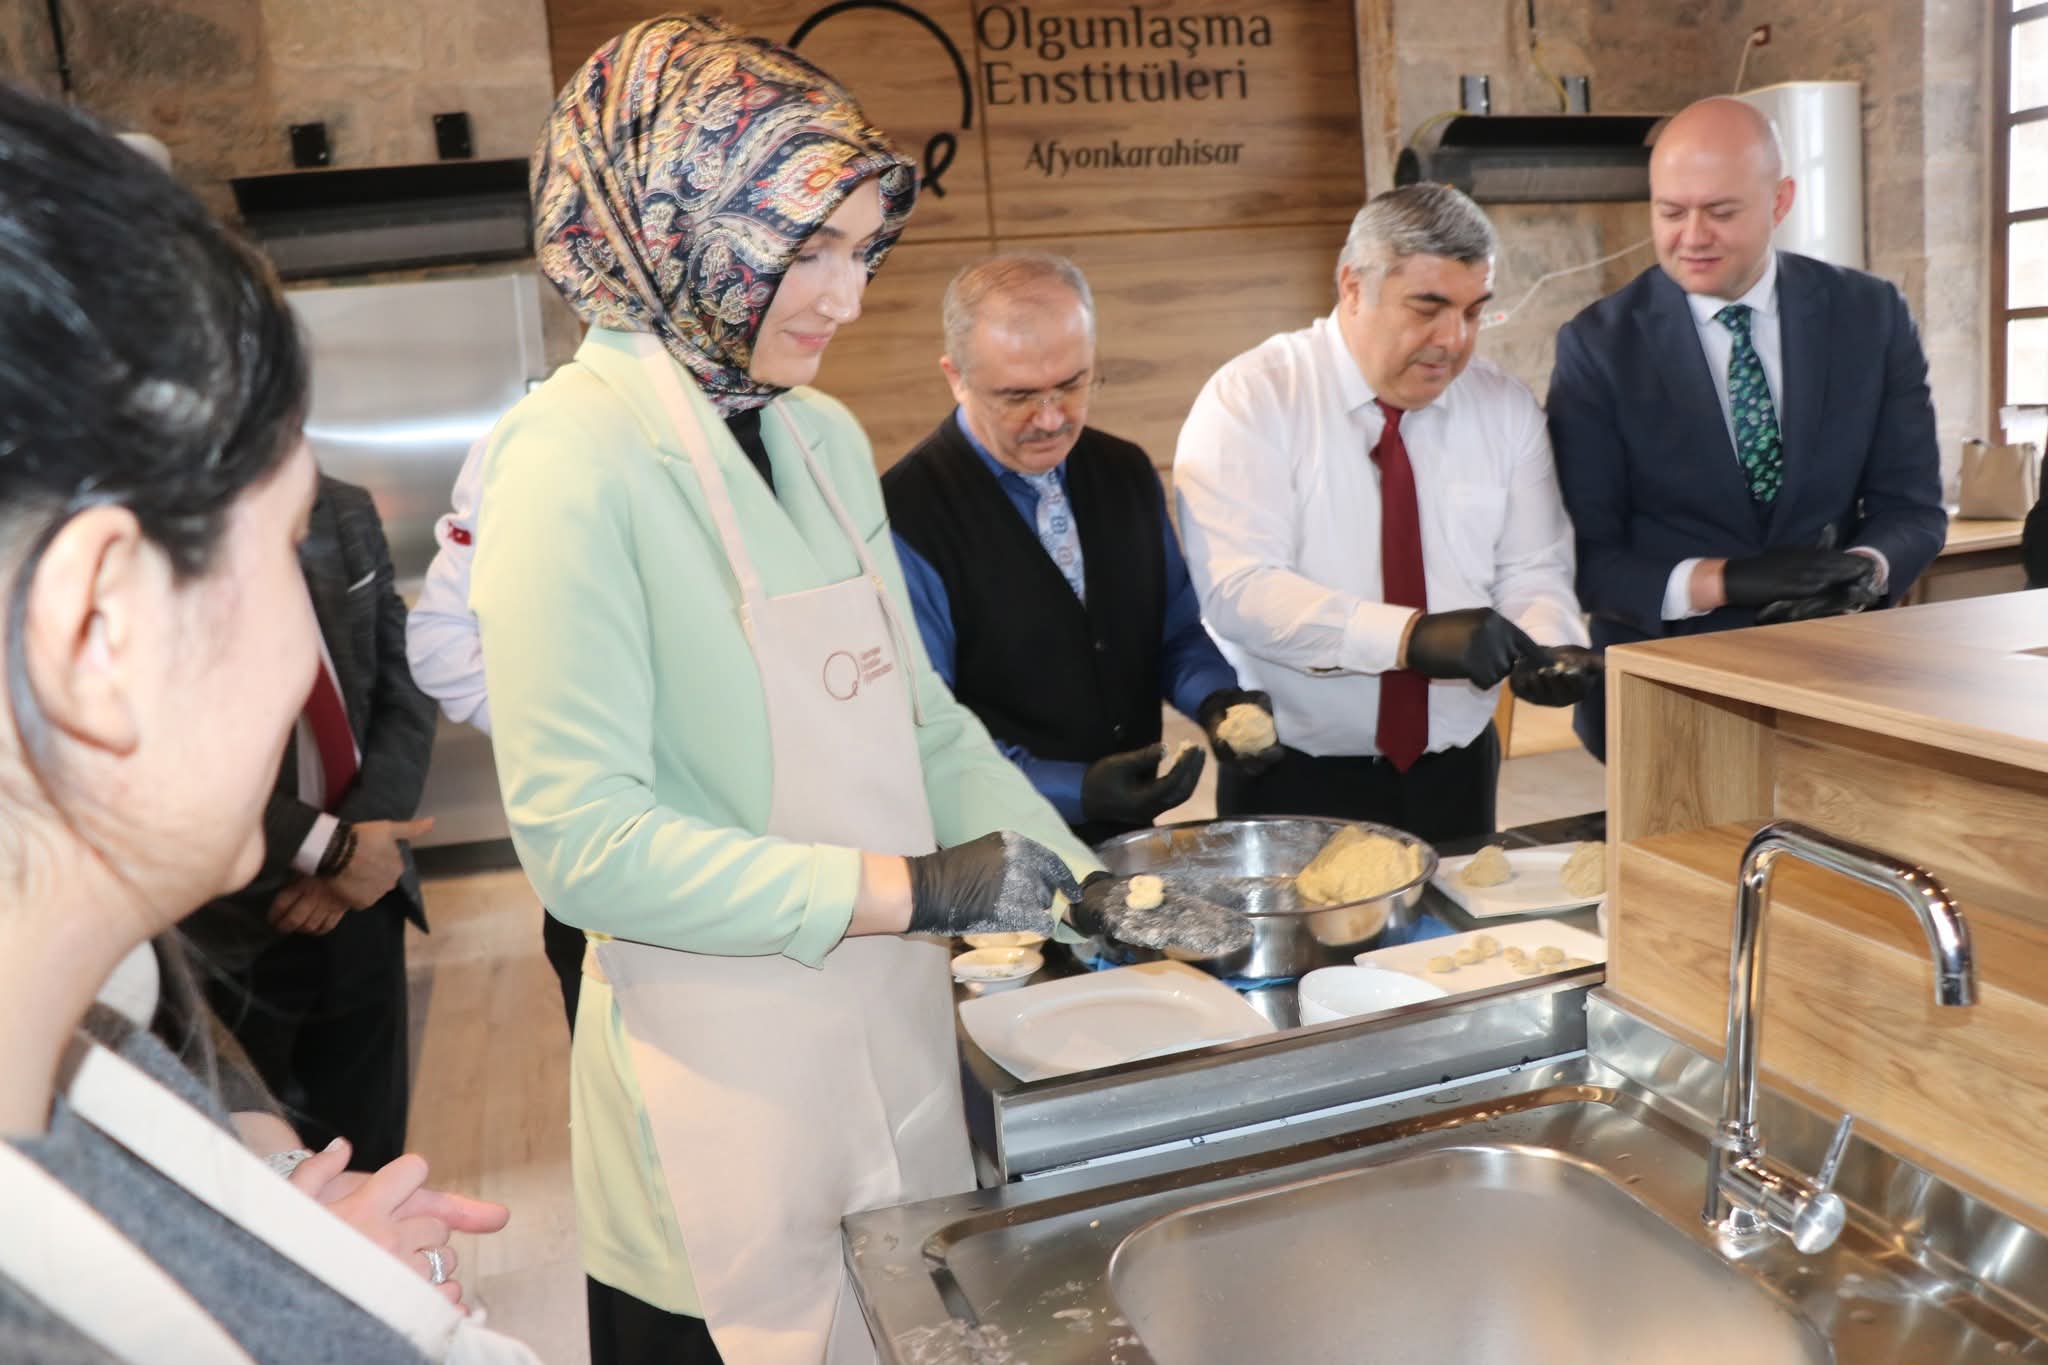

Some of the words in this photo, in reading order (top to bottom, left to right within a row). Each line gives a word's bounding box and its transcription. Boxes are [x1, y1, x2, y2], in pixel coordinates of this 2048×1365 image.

[979, 5, 1272, 60] Olgunlaşma
[985, 60, 1248, 105] Enstitüleri
[1026, 140, 1243, 177] Afyonkarahisar
